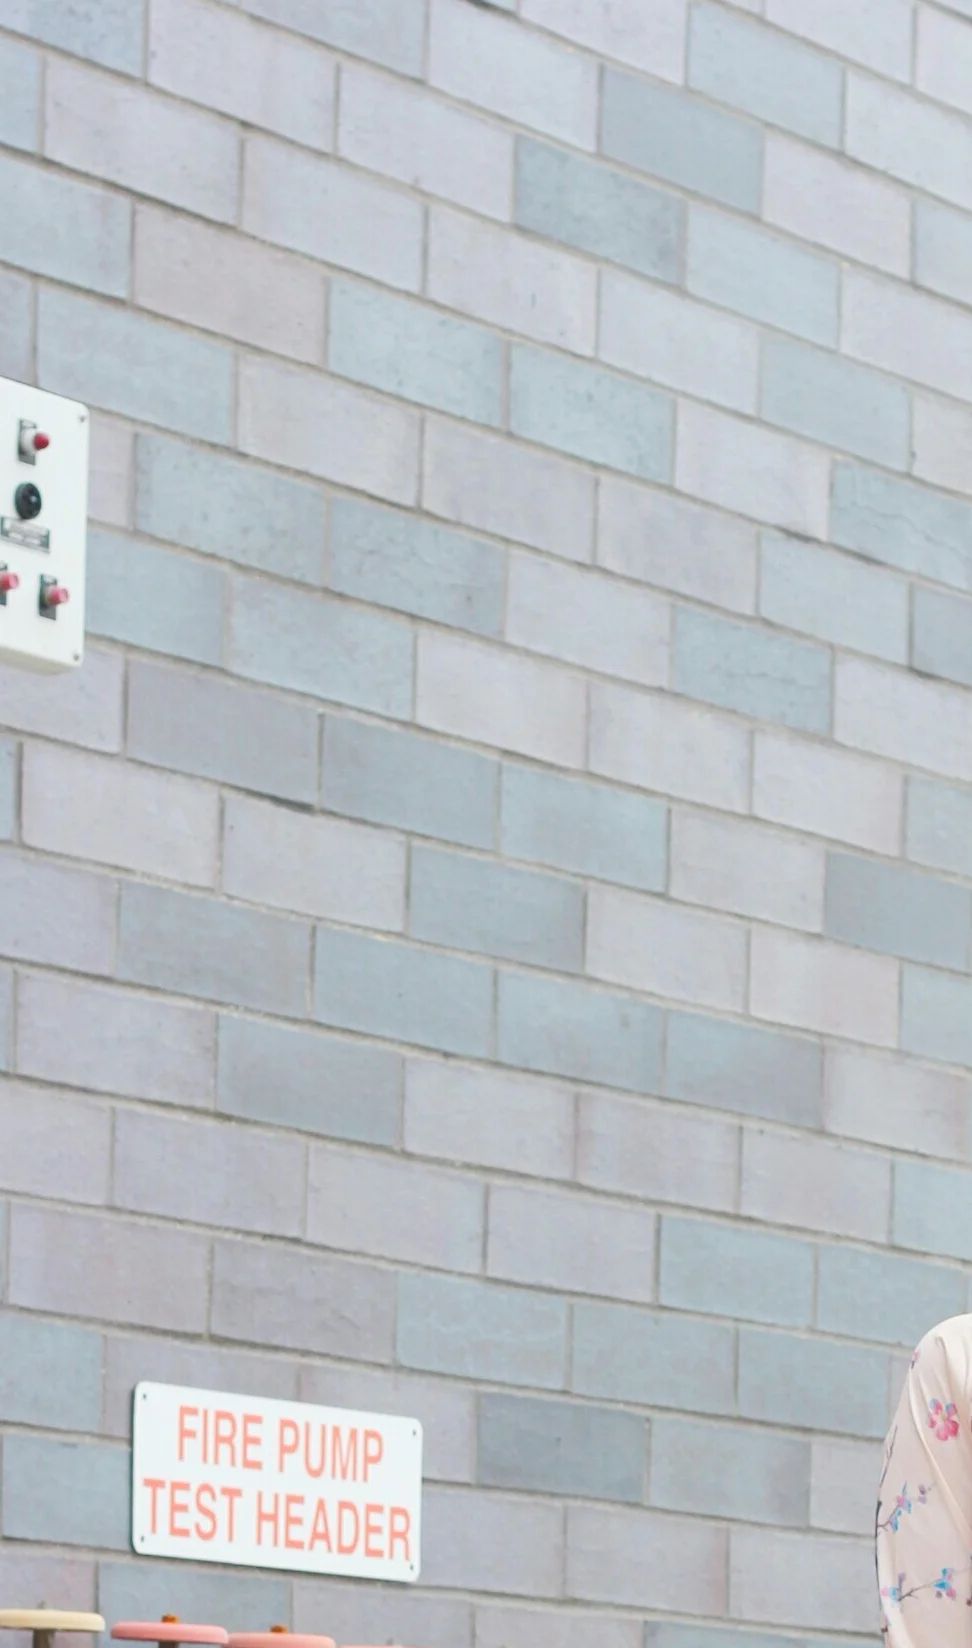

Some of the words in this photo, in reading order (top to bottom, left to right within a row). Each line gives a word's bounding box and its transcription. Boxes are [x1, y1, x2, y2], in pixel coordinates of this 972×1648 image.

[178, 1405, 263, 1470] FIRE
[279, 1418, 383, 1482] PUMP
[143, 1477, 242, 1542] TEST
[255, 1490, 411, 1560] HEADER
